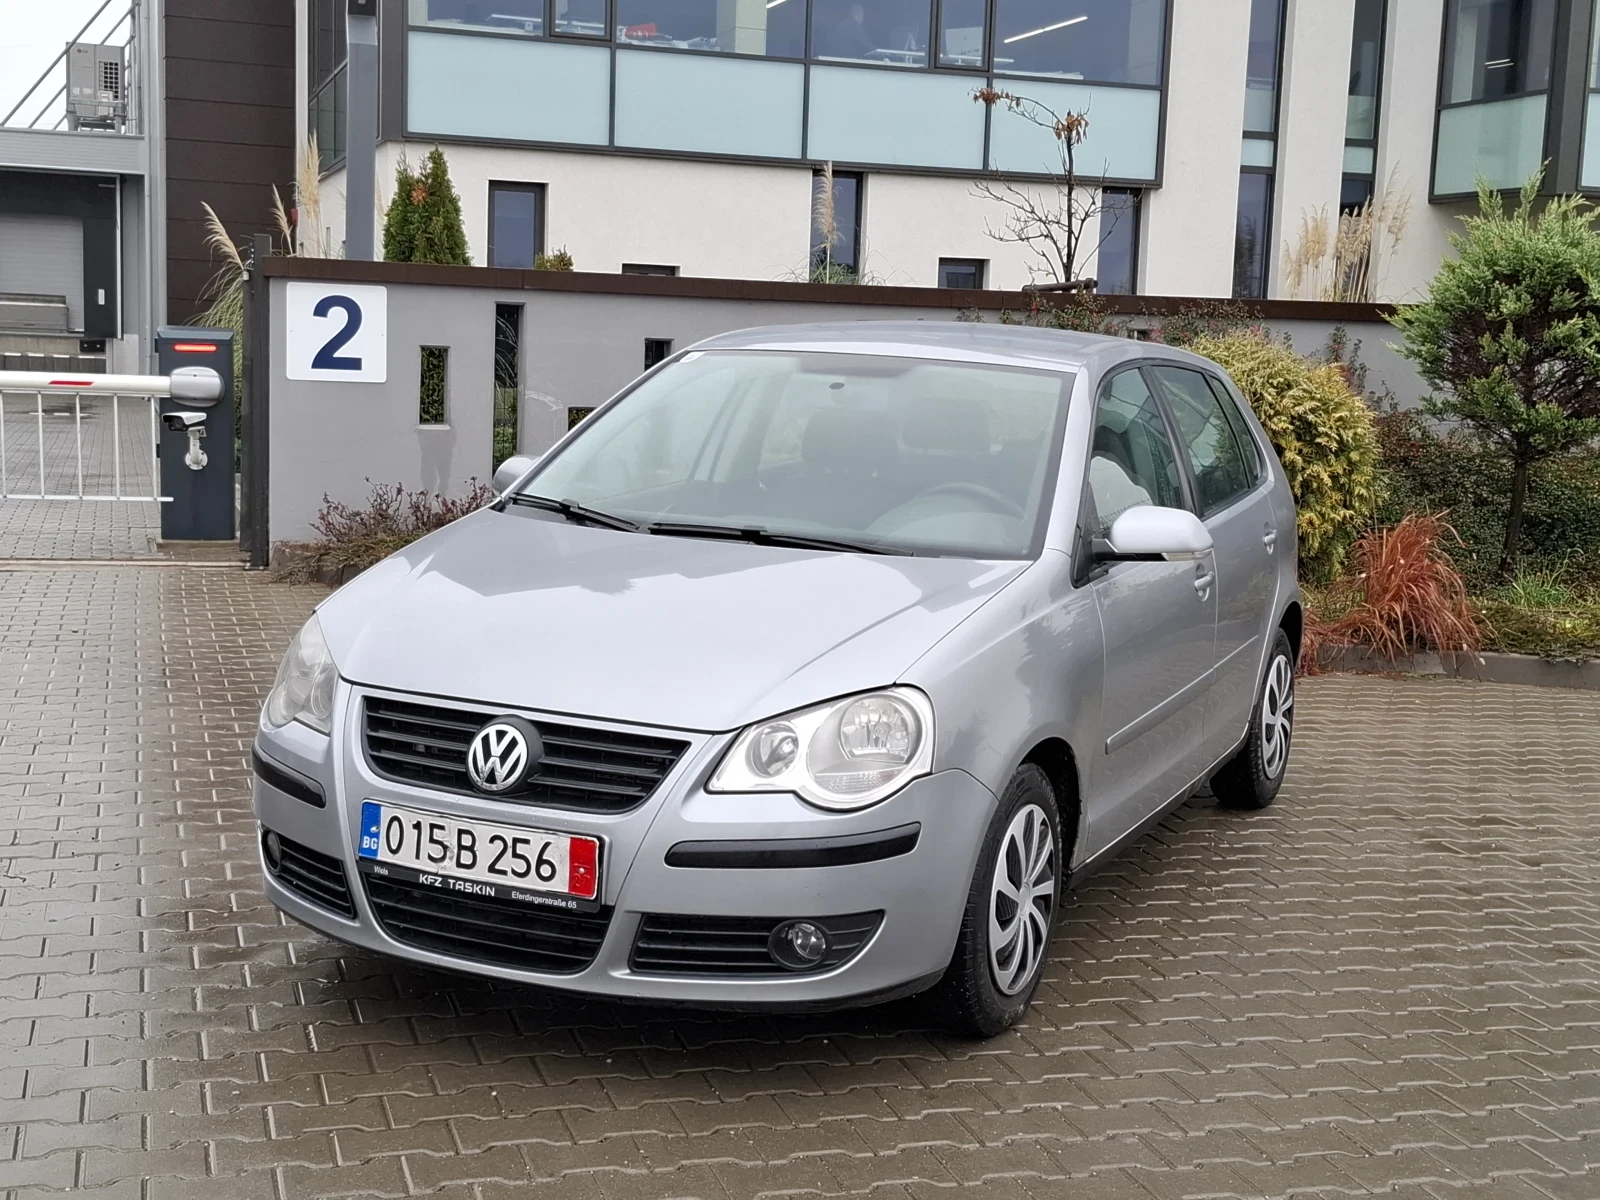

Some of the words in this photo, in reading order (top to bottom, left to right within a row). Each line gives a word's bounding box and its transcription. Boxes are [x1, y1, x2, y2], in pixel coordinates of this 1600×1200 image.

[311, 295, 362, 371] 2
[468, 723, 528, 791] VW
[362, 835, 378, 850] BG
[487, 834, 557, 882] 256
[419, 873, 443, 887] KFZ
[447, 879, 495, 897] TASKIN
